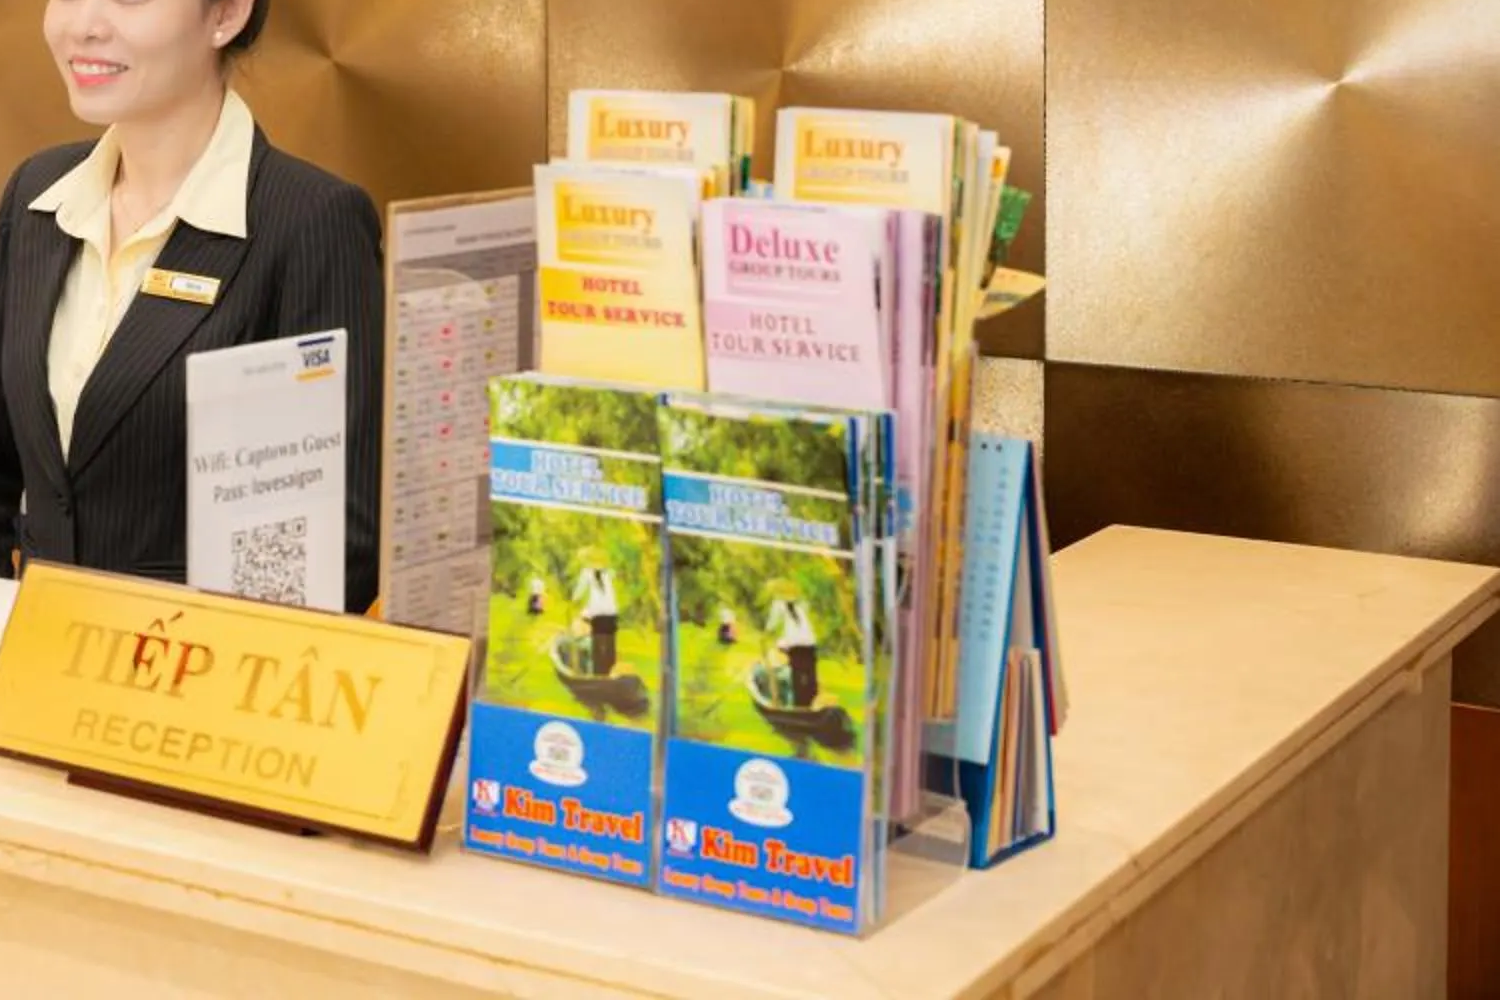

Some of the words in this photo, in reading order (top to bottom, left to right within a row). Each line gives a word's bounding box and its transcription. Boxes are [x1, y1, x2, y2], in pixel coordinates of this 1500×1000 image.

[596, 109, 691, 147] Luxury
[803, 129, 906, 168] Luxury
[562, 195, 655, 235] Luxury
[728, 223, 840, 264] Deluxe
[581, 276, 643, 296] HOTEL
[787, 266, 841, 282] TOURS
[547, 301, 597, 319] TOUR
[603, 305, 687, 328] SERVICE
[749, 312, 816, 336] HOTEL
[302, 349, 331, 369] VISA
[712, 333, 765, 354] TOUR
[771, 338, 861, 363] SERVICE
[302, 432, 341, 455] Guest
[60, 611, 216, 700] TIẾP
[234, 646, 382, 735] TÂN
[73, 707, 317, 789] RECEPTION
[503, 785, 557, 826] Kim
[560, 796, 644, 844] Travel
[700, 825, 759, 870] Kim
[763, 837, 855, 888] Travel
